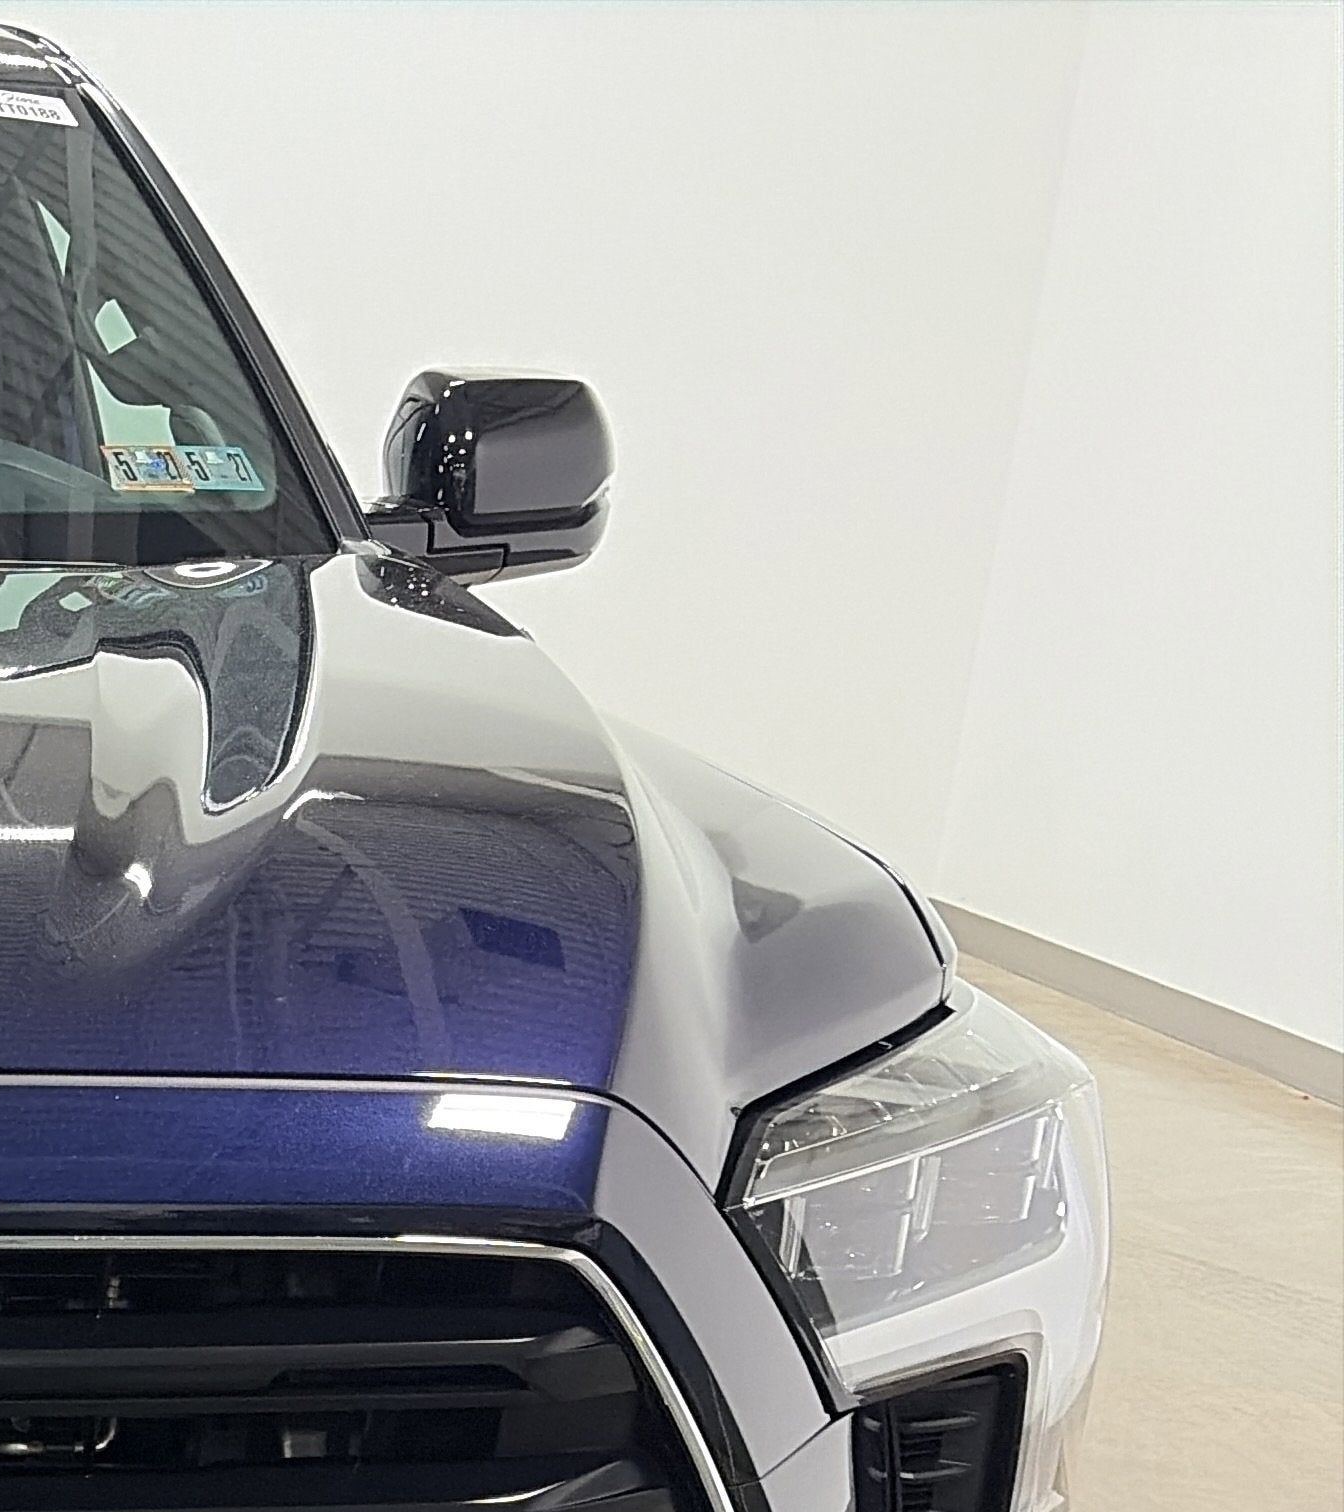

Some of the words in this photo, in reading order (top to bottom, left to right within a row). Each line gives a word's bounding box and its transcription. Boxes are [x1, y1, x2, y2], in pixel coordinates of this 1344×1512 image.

[113, 451, 138, 481] 5
[185, 451, 210, 481] 5
[226, 452, 253, 482] 27
